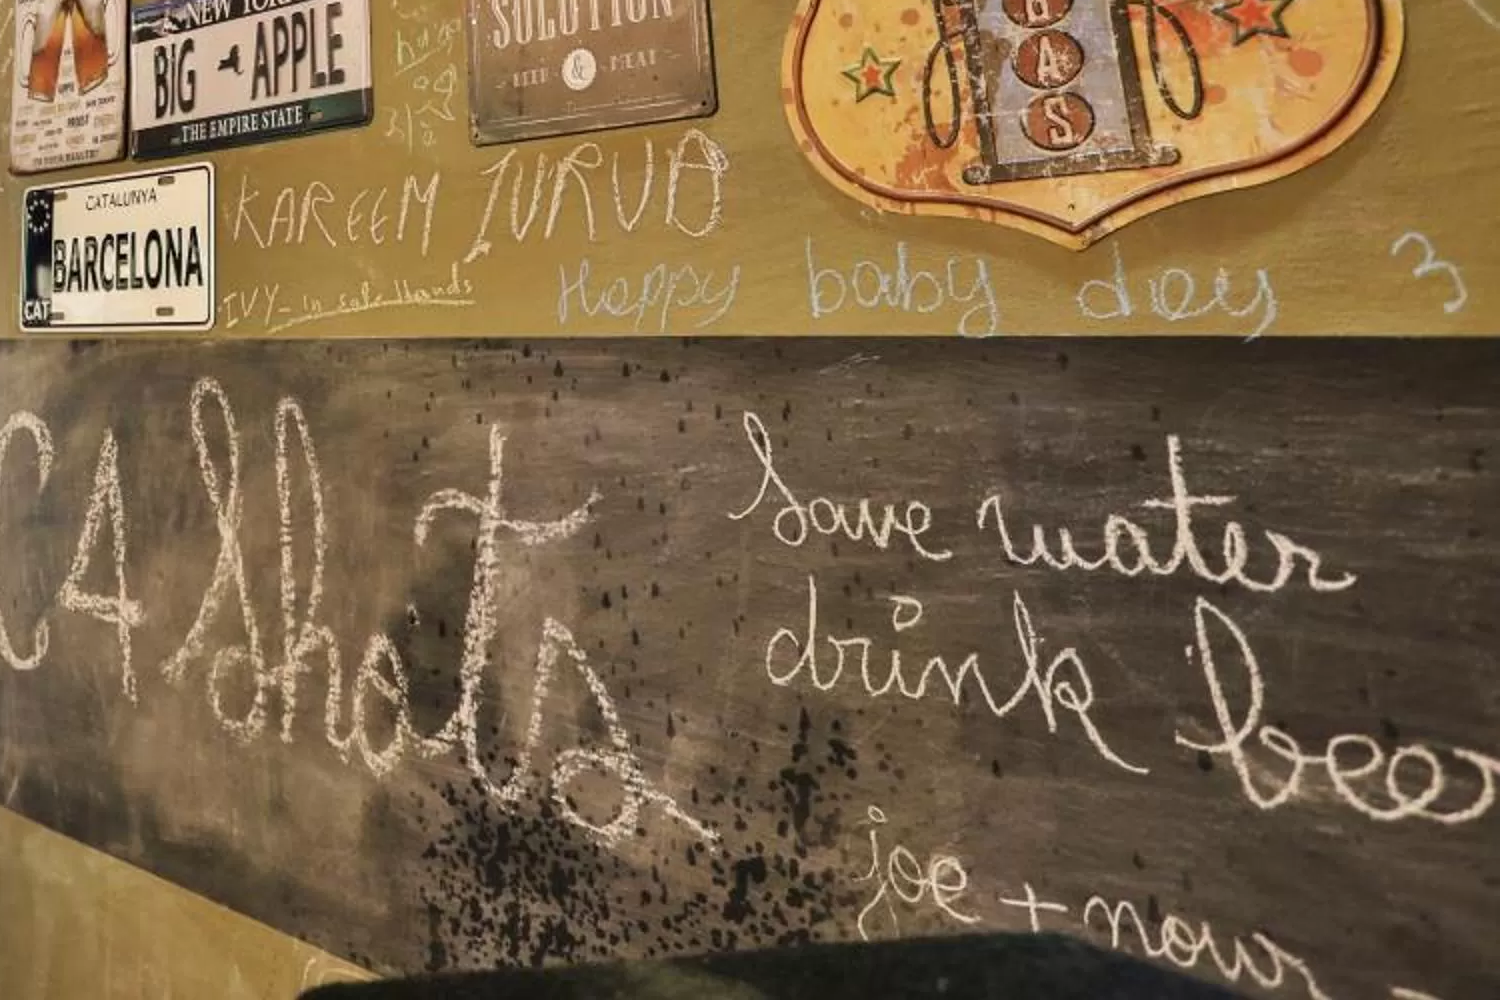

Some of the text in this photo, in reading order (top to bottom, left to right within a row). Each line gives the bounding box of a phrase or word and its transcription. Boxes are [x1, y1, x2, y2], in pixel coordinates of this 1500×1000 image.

[154, 38, 196, 119] BIG
[251, 2, 345, 101] APPLE
[181, 105, 304, 144] THE EMPIRE STATE
[85, 188, 157, 211] CATALUNYA
[232, 172, 442, 257] KAREEM
[53, 225, 203, 293] BARCELONA
[805, 236, 997, 338] baby
[24, 302, 50, 320] CAT
[728, 411, 1358, 592] Save water
[766, 574, 1151, 774] drink
